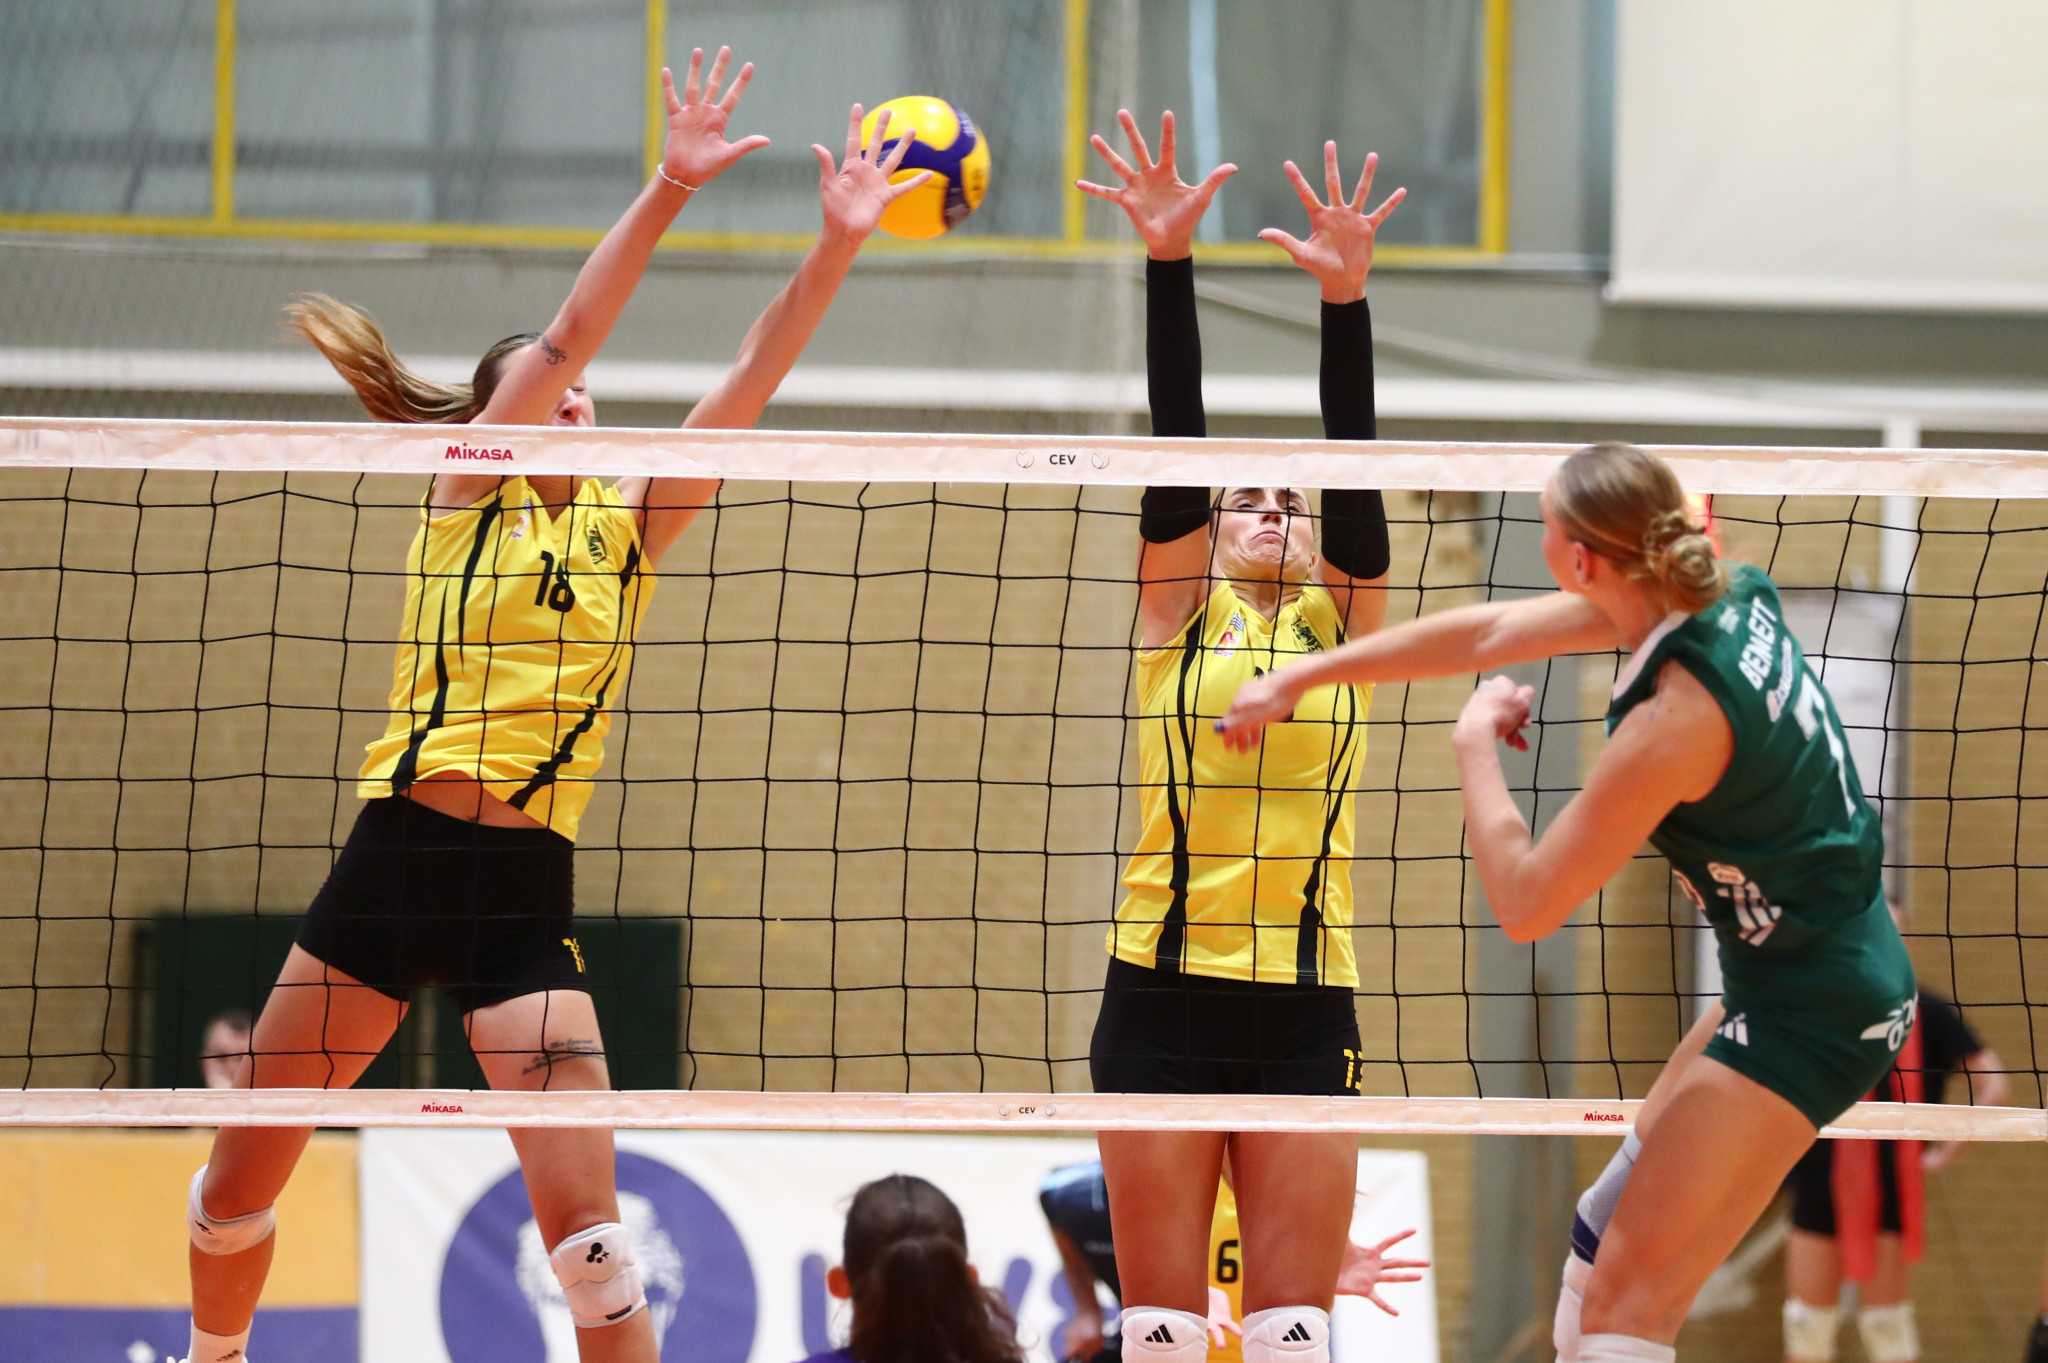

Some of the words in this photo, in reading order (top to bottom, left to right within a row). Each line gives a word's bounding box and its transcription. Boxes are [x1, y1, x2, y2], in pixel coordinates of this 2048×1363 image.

[1049, 454, 1076, 465] CEV
[534, 550, 576, 613] 18
[1018, 1106, 1036, 1114] CEV
[1217, 1239, 1239, 1284] 6
